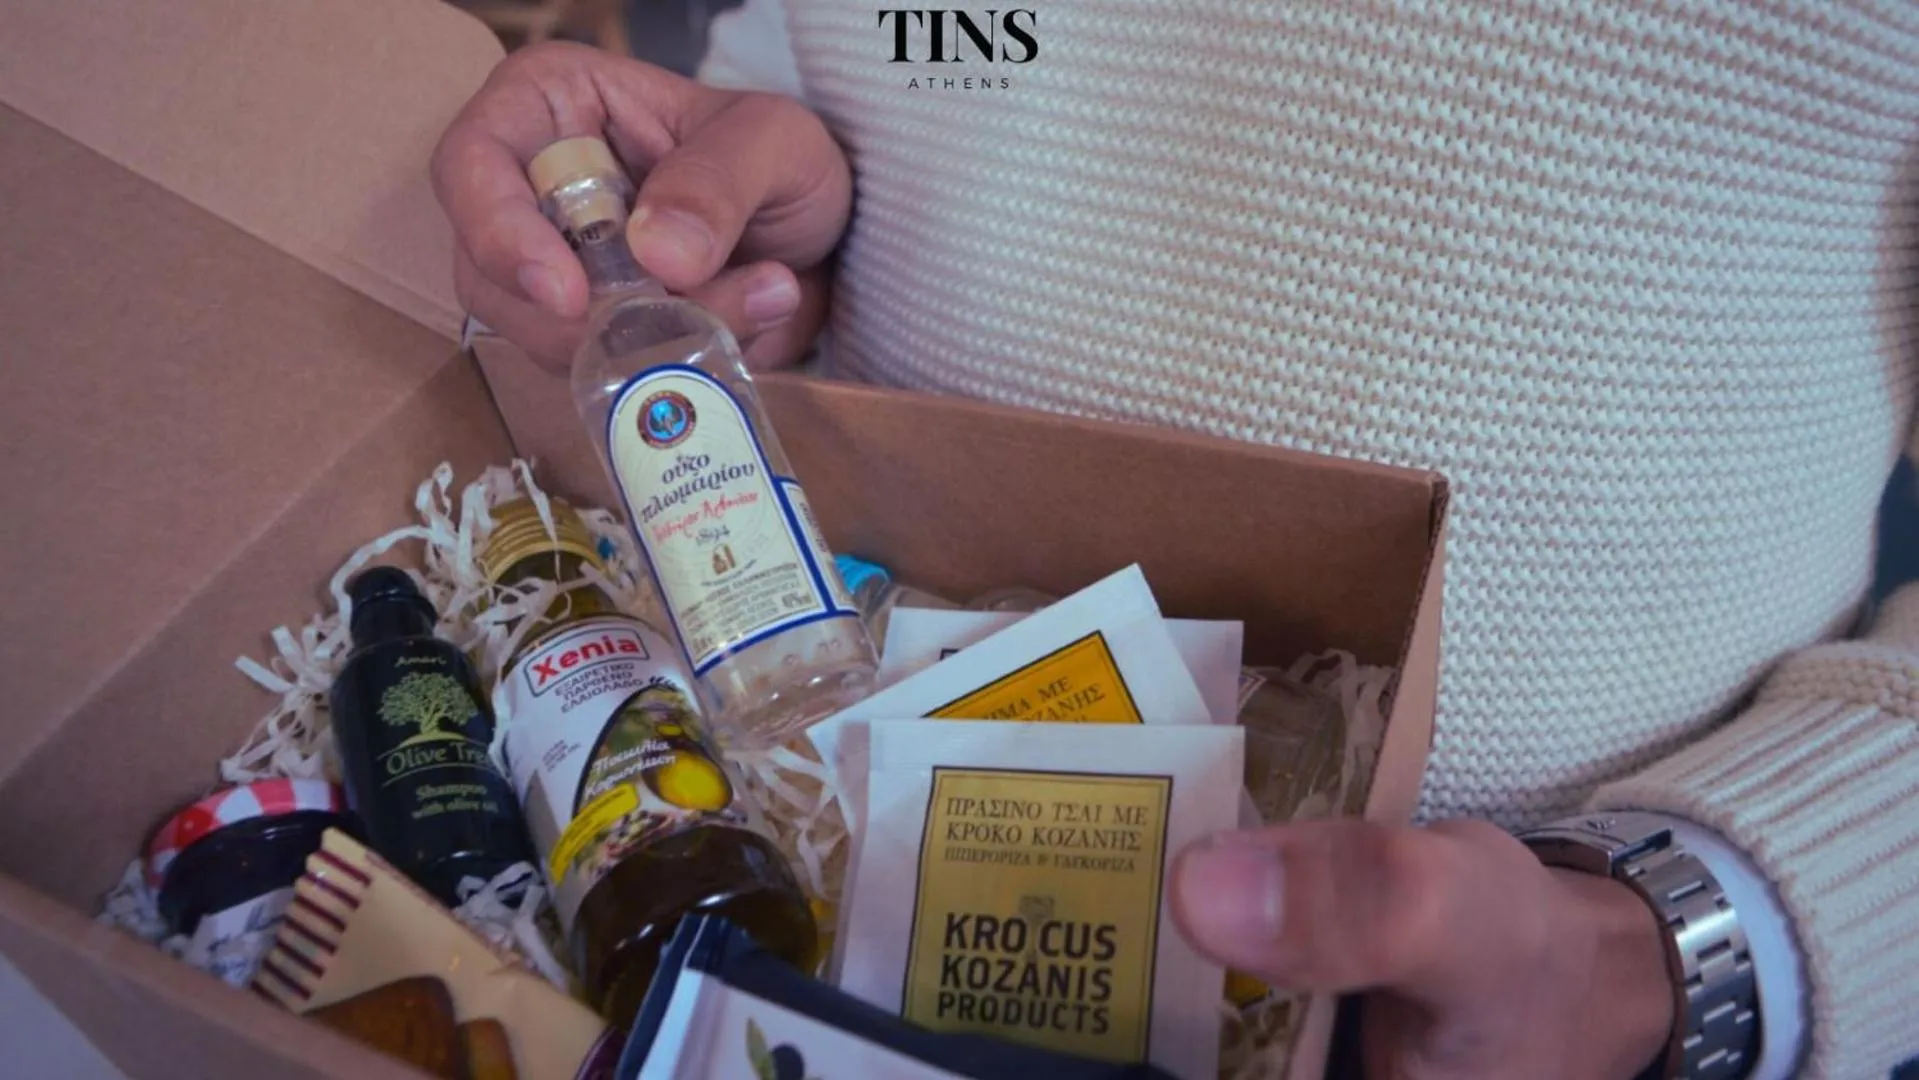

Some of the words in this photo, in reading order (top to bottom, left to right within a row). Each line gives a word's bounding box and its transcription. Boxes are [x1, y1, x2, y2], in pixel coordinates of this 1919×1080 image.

[532, 634, 639, 687] Xenia
[387, 748, 448, 775] Olive
[946, 797, 1042, 821] ΠΡΑΣΙΝΟ
[1112, 806, 1149, 827] ΜΕ
[946, 821, 1022, 845] ΚΡΟΚΟ
[1032, 825, 1142, 851] ΚΟΖΑΝΗΣ
[940, 954, 1113, 1003] KOZANIS
[936, 991, 1111, 1036] PRODUCTS
